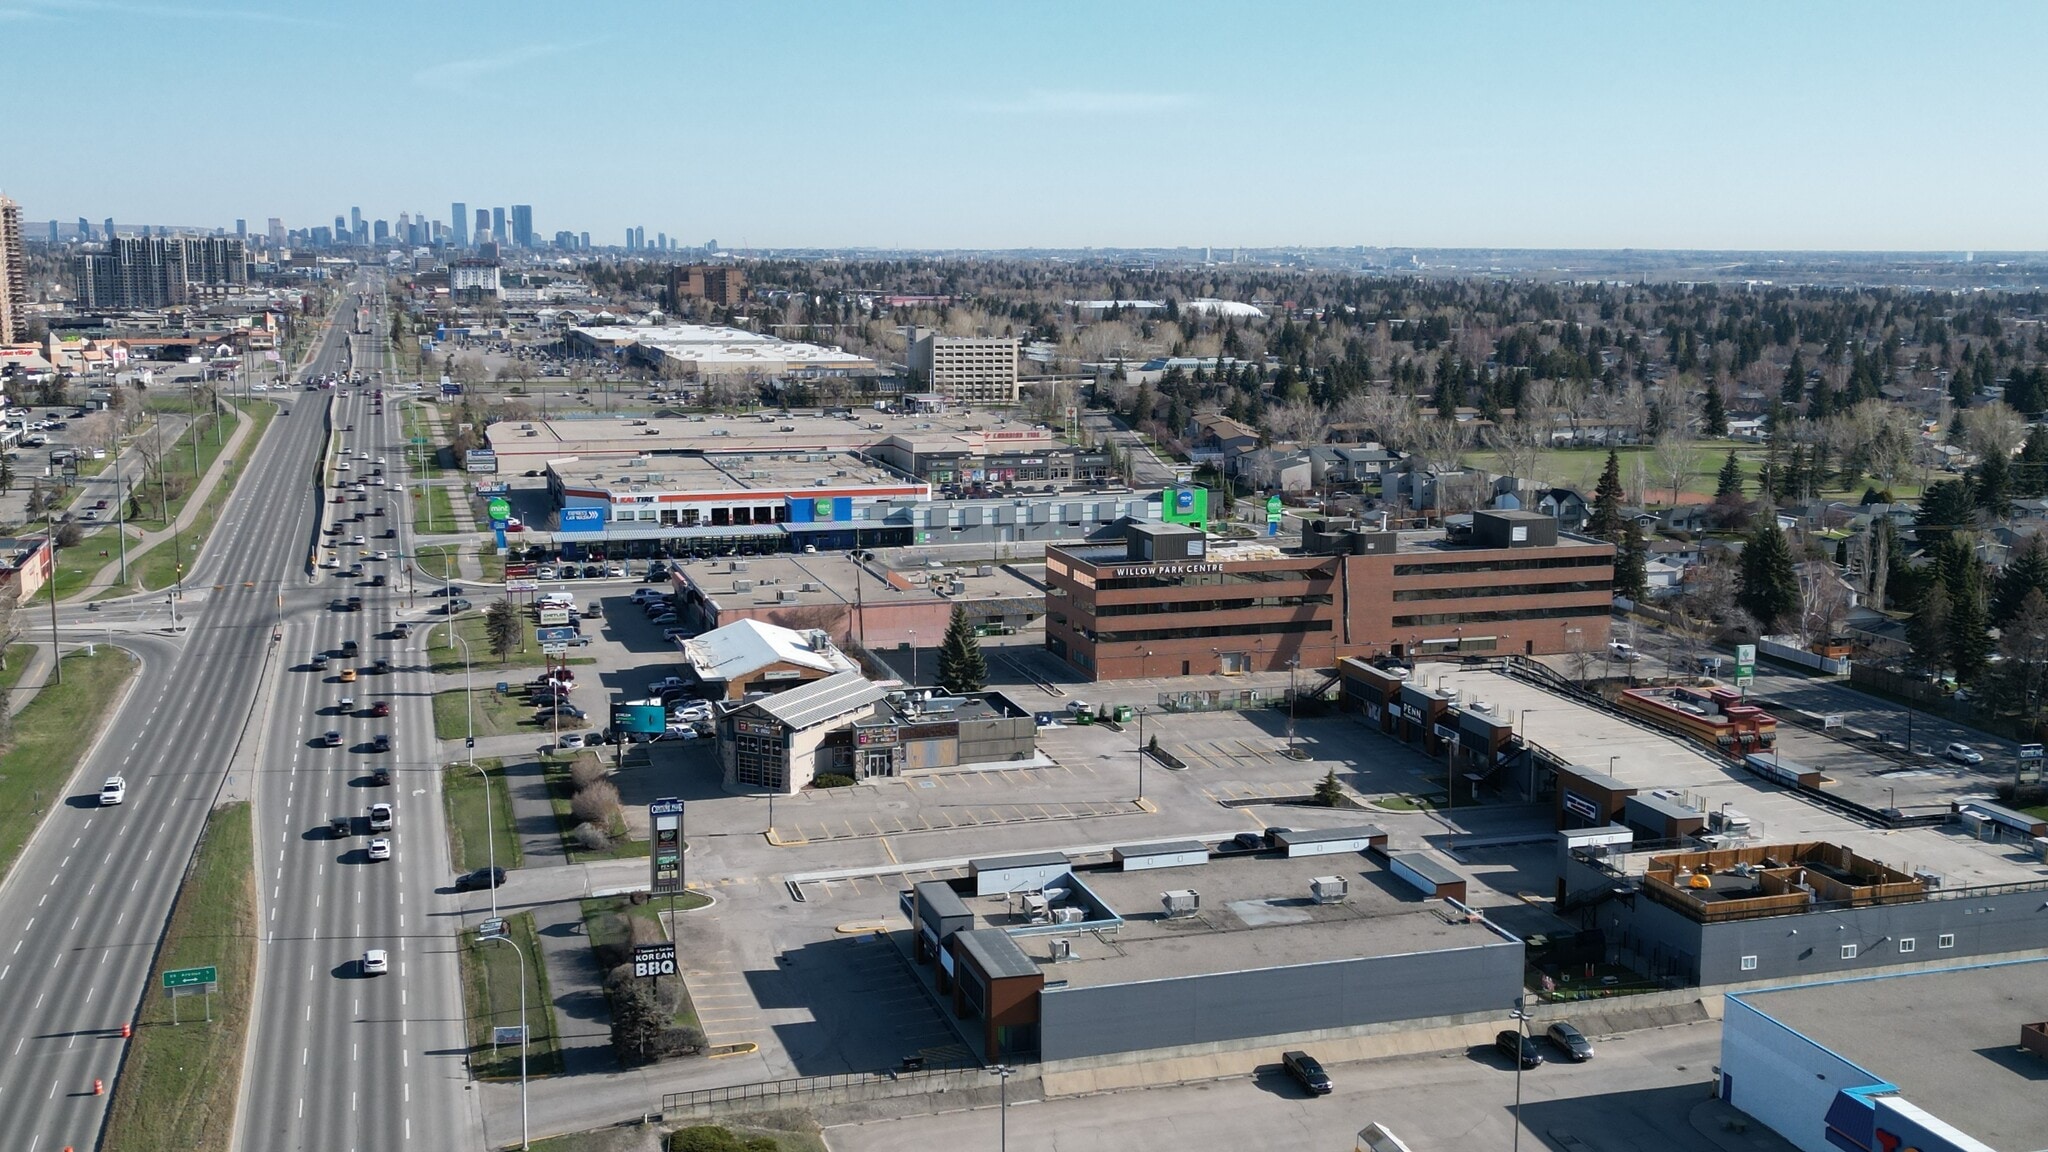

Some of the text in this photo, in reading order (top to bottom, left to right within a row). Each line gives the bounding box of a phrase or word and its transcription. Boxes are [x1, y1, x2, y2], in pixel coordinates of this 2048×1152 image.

[1117, 563, 1223, 576] WILLOW PARK CENTRE
[1403, 703, 1422, 719] PENN
[635, 951, 674, 962] KOREAN
[636, 960, 674, 977] BBQ
